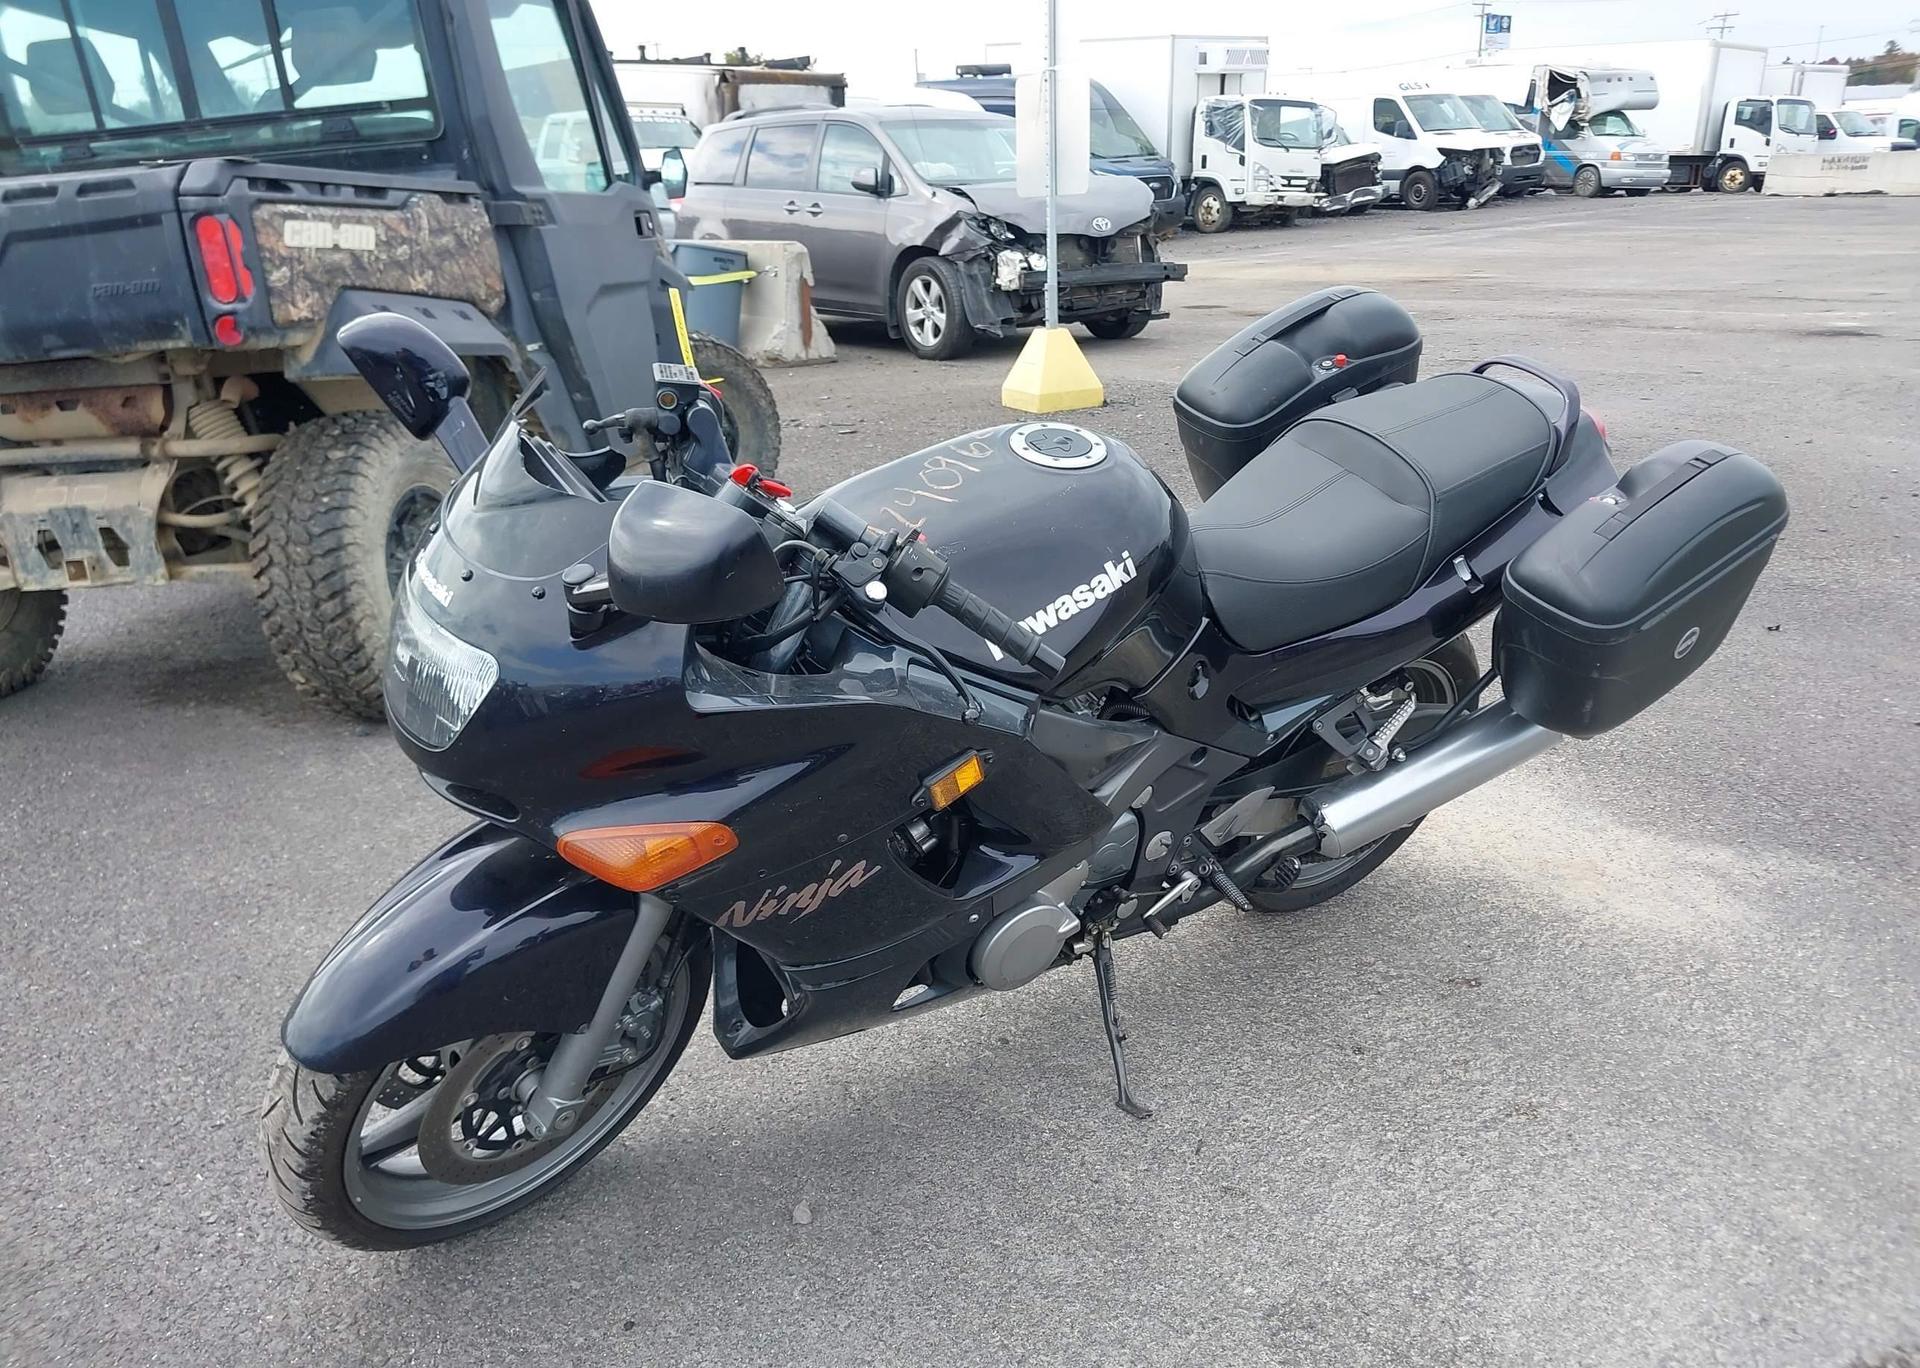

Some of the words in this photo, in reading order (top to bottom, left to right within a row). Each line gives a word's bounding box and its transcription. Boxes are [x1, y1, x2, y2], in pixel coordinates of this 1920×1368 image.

[284, 220, 375, 251] can-am
[985, 550, 1138, 662] wasaki
[715, 859, 882, 928] Ninja
